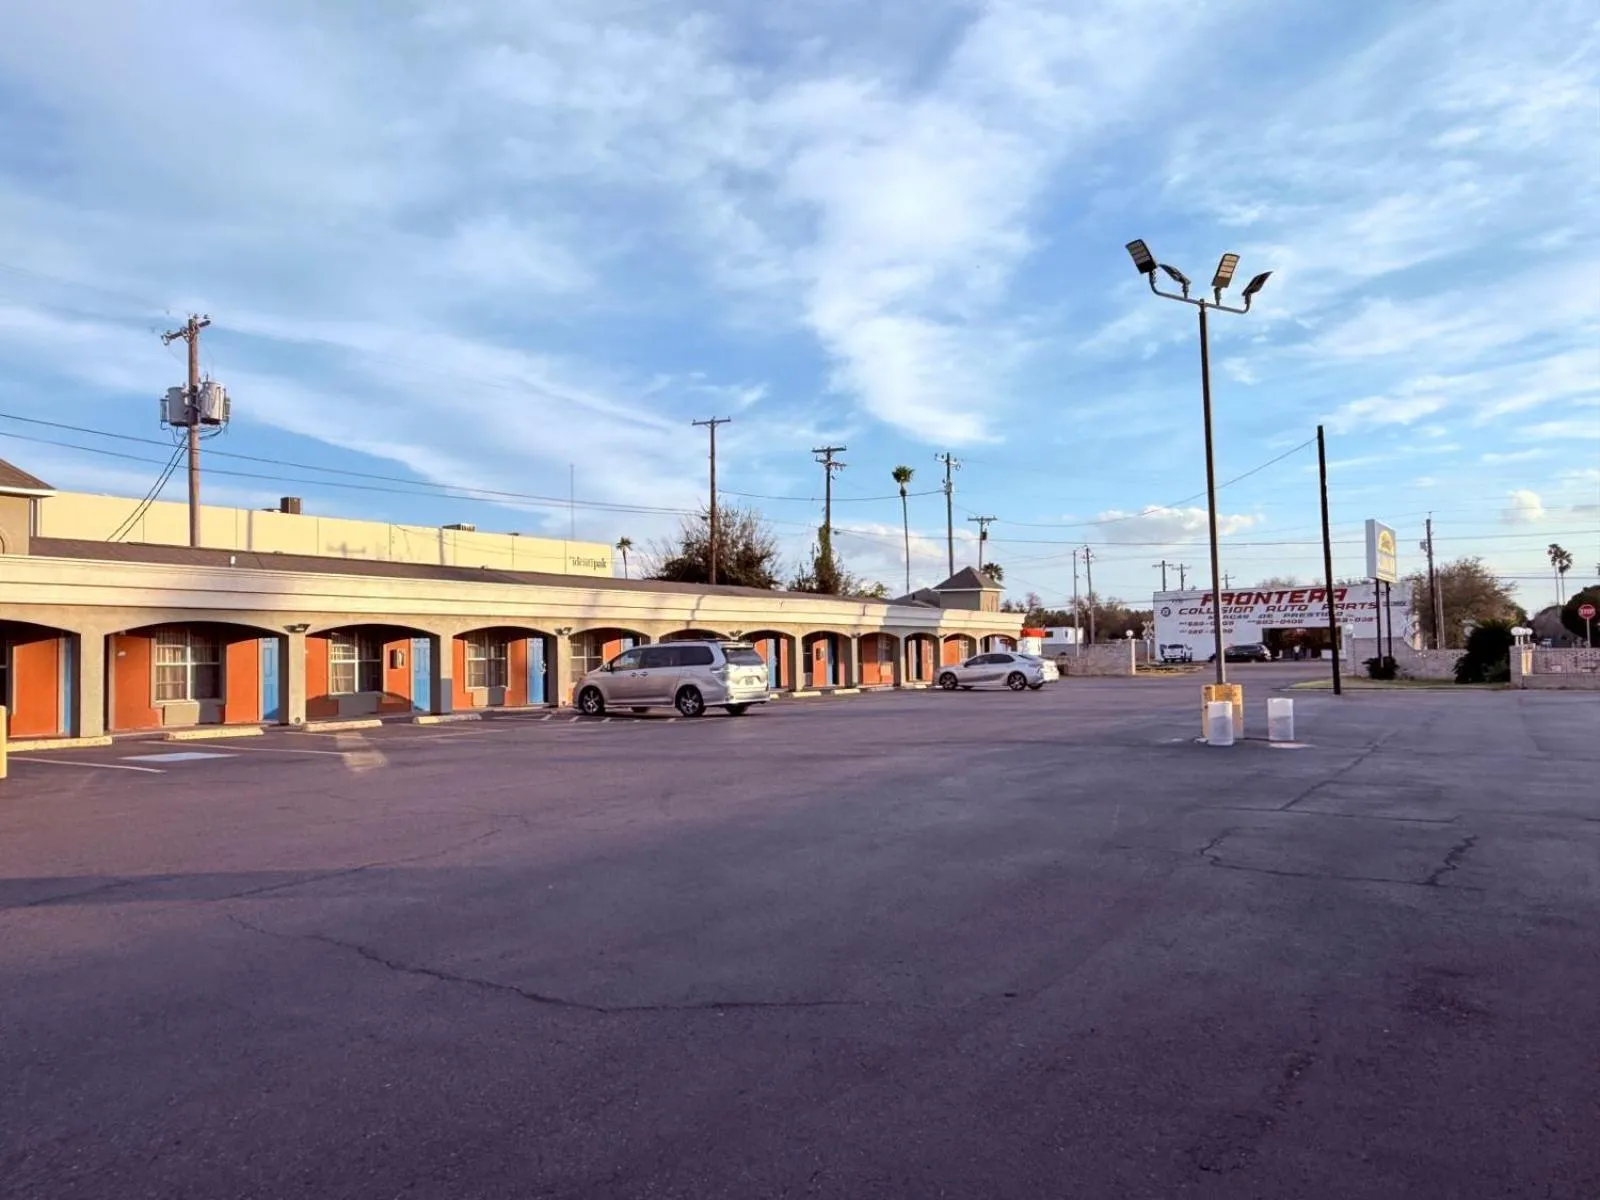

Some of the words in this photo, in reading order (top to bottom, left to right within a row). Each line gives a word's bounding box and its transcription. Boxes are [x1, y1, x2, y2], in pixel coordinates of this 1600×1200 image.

[1200, 588, 1348, 606] FRONTERA
[1178, 605, 1254, 615] COLLSION
[1265, 604, 1309, 612] AUTO
[1321, 602, 1377, 611] PARTS
